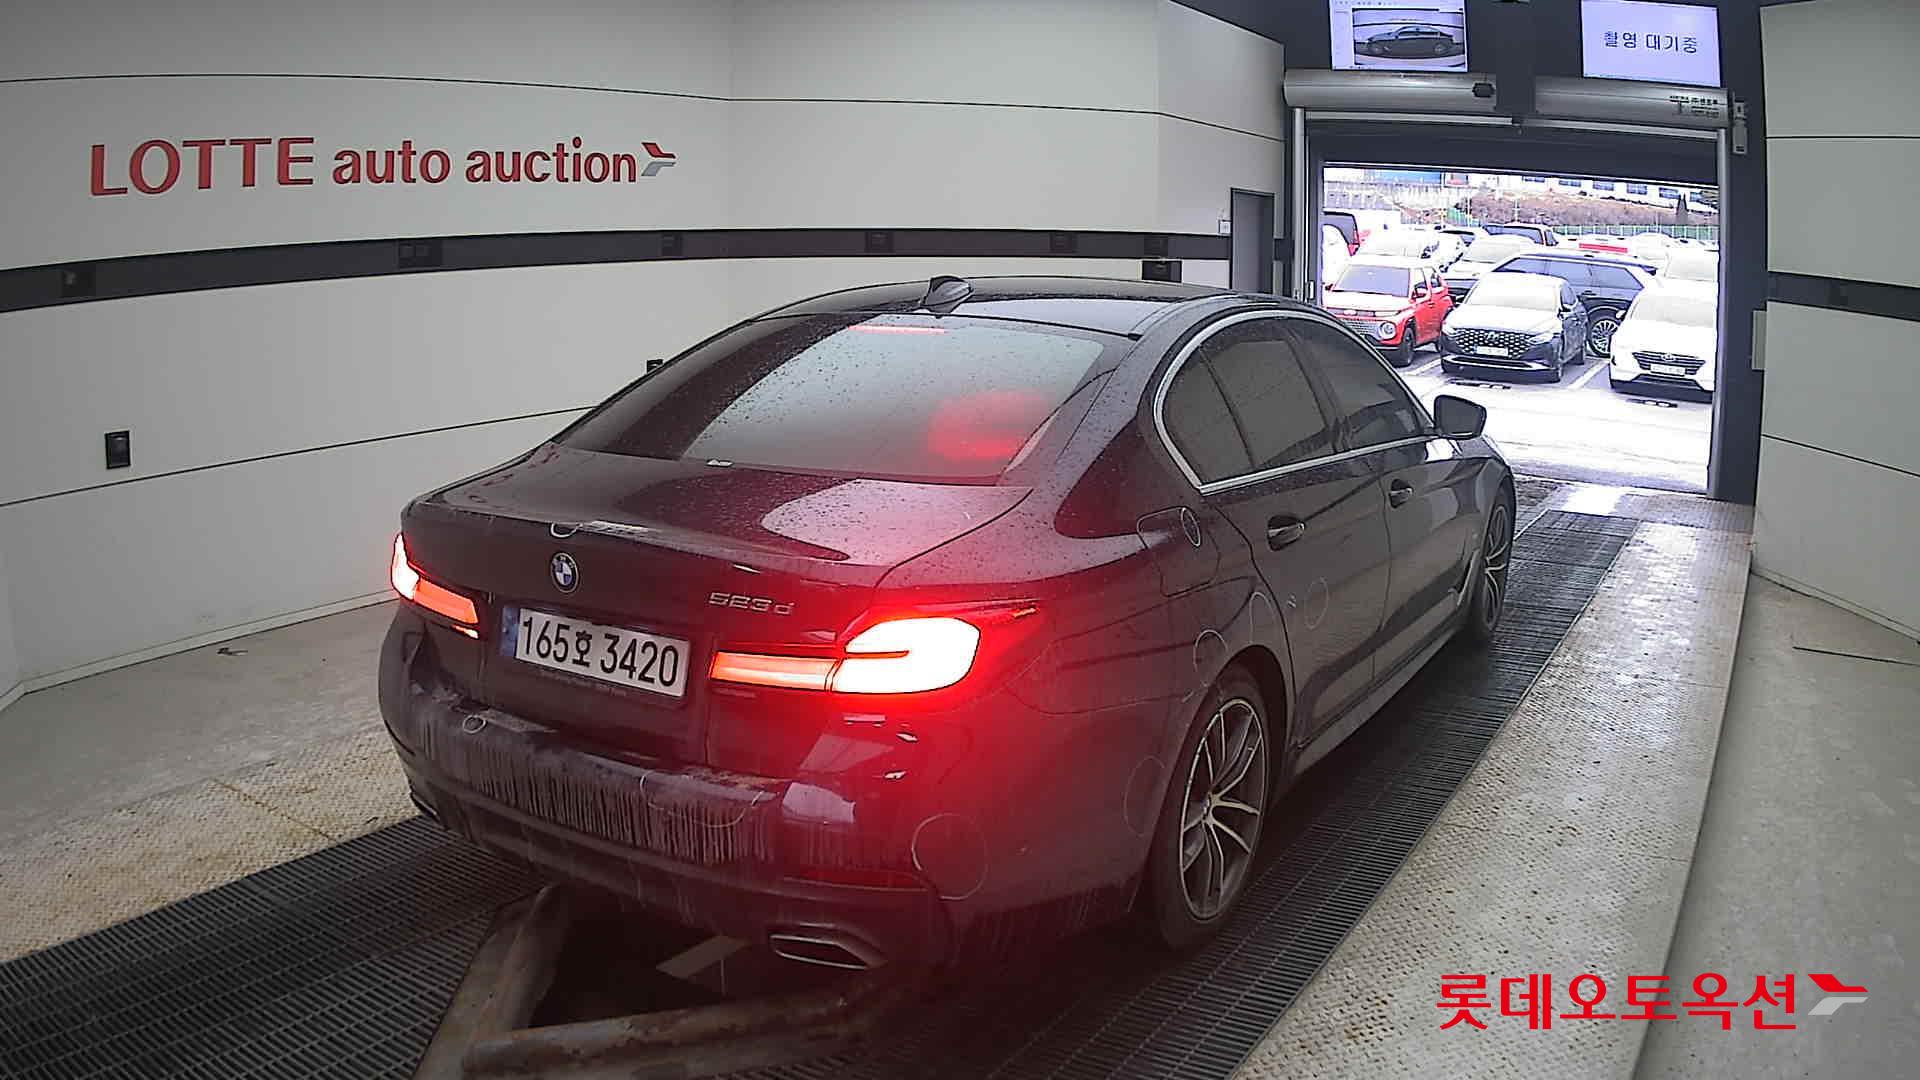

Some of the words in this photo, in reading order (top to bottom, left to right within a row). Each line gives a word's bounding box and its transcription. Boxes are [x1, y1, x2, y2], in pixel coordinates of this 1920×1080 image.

[1645, 33, 1698, 54] 대기중
[90, 136, 315, 196] LOTTE
[332, 139, 451, 185] auto
[464, 136, 638, 184] auction
[708, 592, 795, 615] 523d
[523, 616, 593, 668] 165호
[600, 632, 679, 688] 3420
